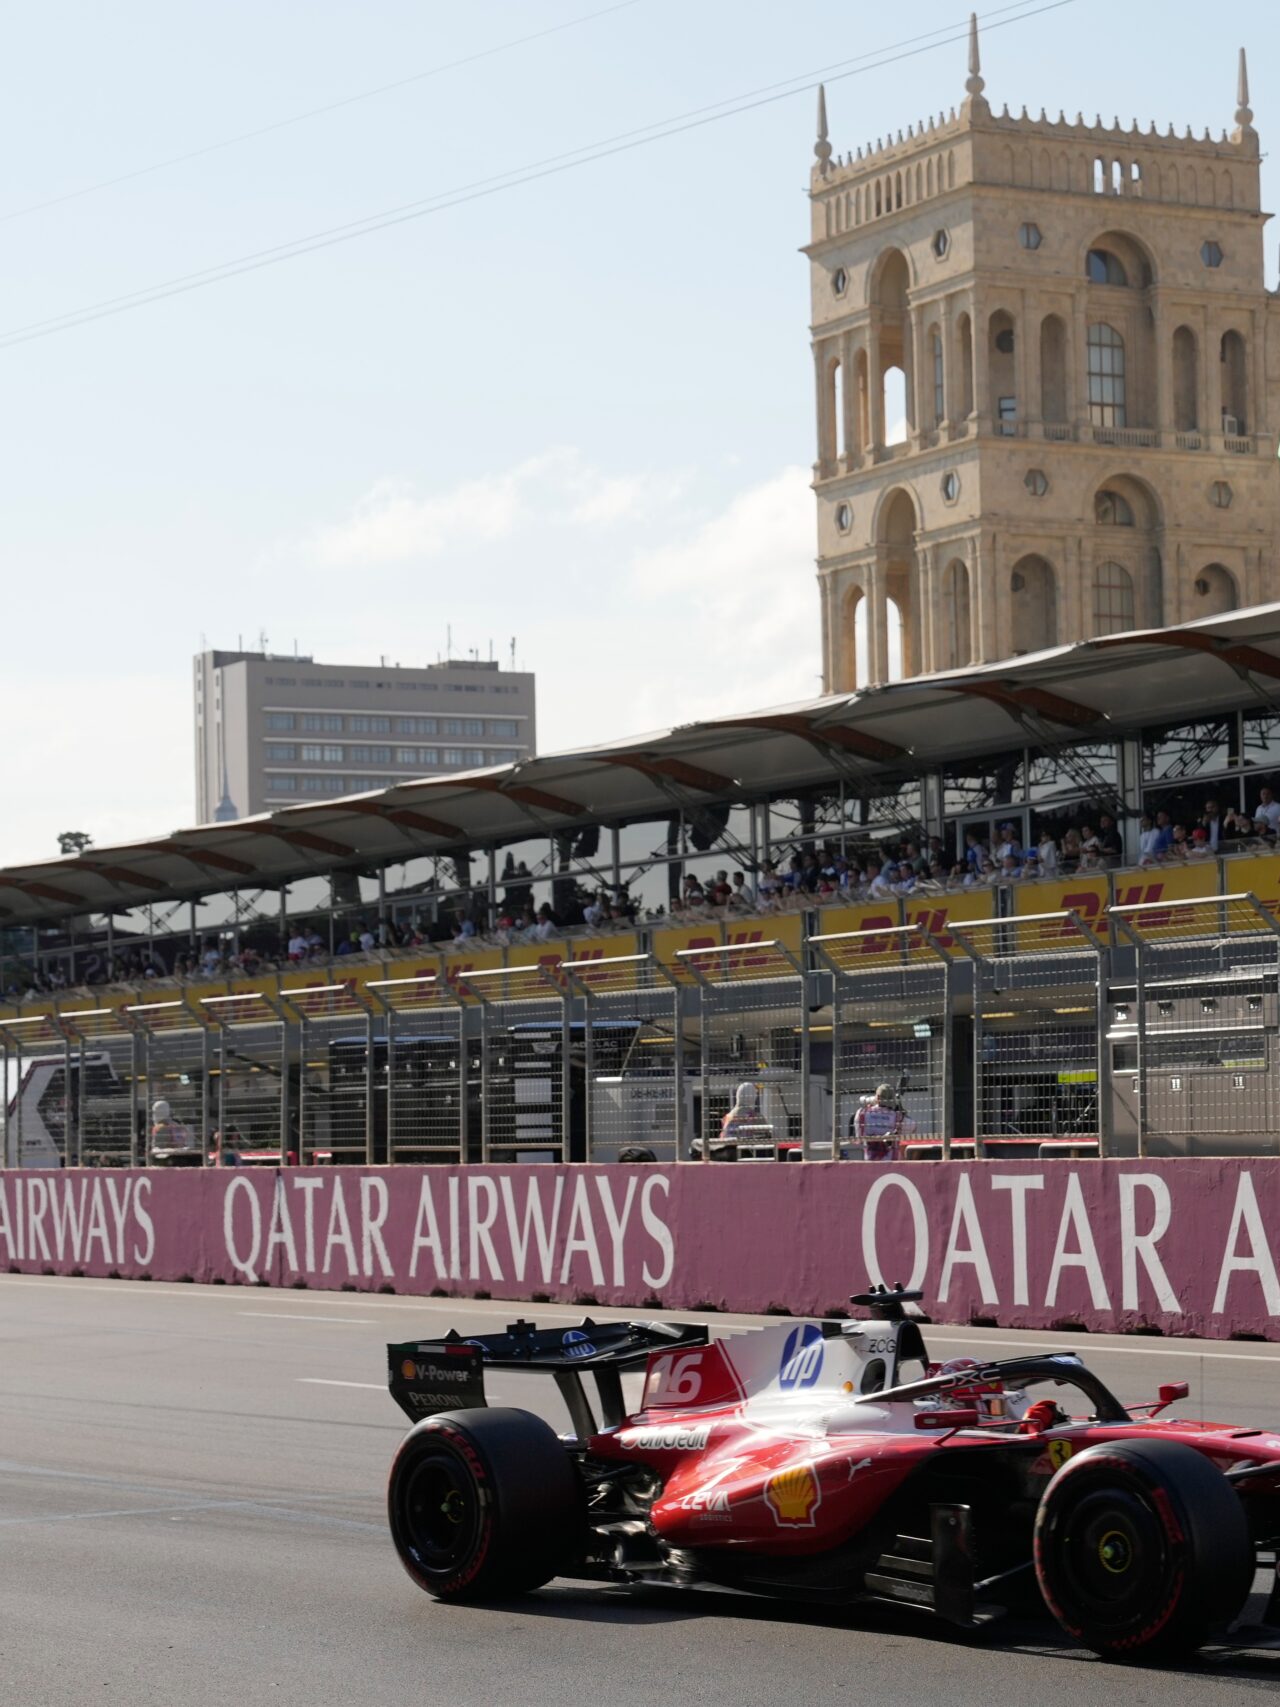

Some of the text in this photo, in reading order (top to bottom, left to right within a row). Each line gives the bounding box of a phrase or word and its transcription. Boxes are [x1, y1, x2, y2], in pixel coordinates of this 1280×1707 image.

[859, 908, 950, 954] DHL
[1056, 883, 1170, 938] DHL
[536, 949, 608, 986] DHL
[685, 931, 768, 973] DHL
[414, 963, 474, 999] DHL
[223, 1172, 675, 1290] QATAR AIRWAYS
[861, 1172, 1181, 1316] QATAR
[416, 1364, 470, 1382] V-Power
[645, 1353, 703, 1405] 16
[781, 1324, 824, 1391] hp
[408, 1391, 465, 1408] PERONI
